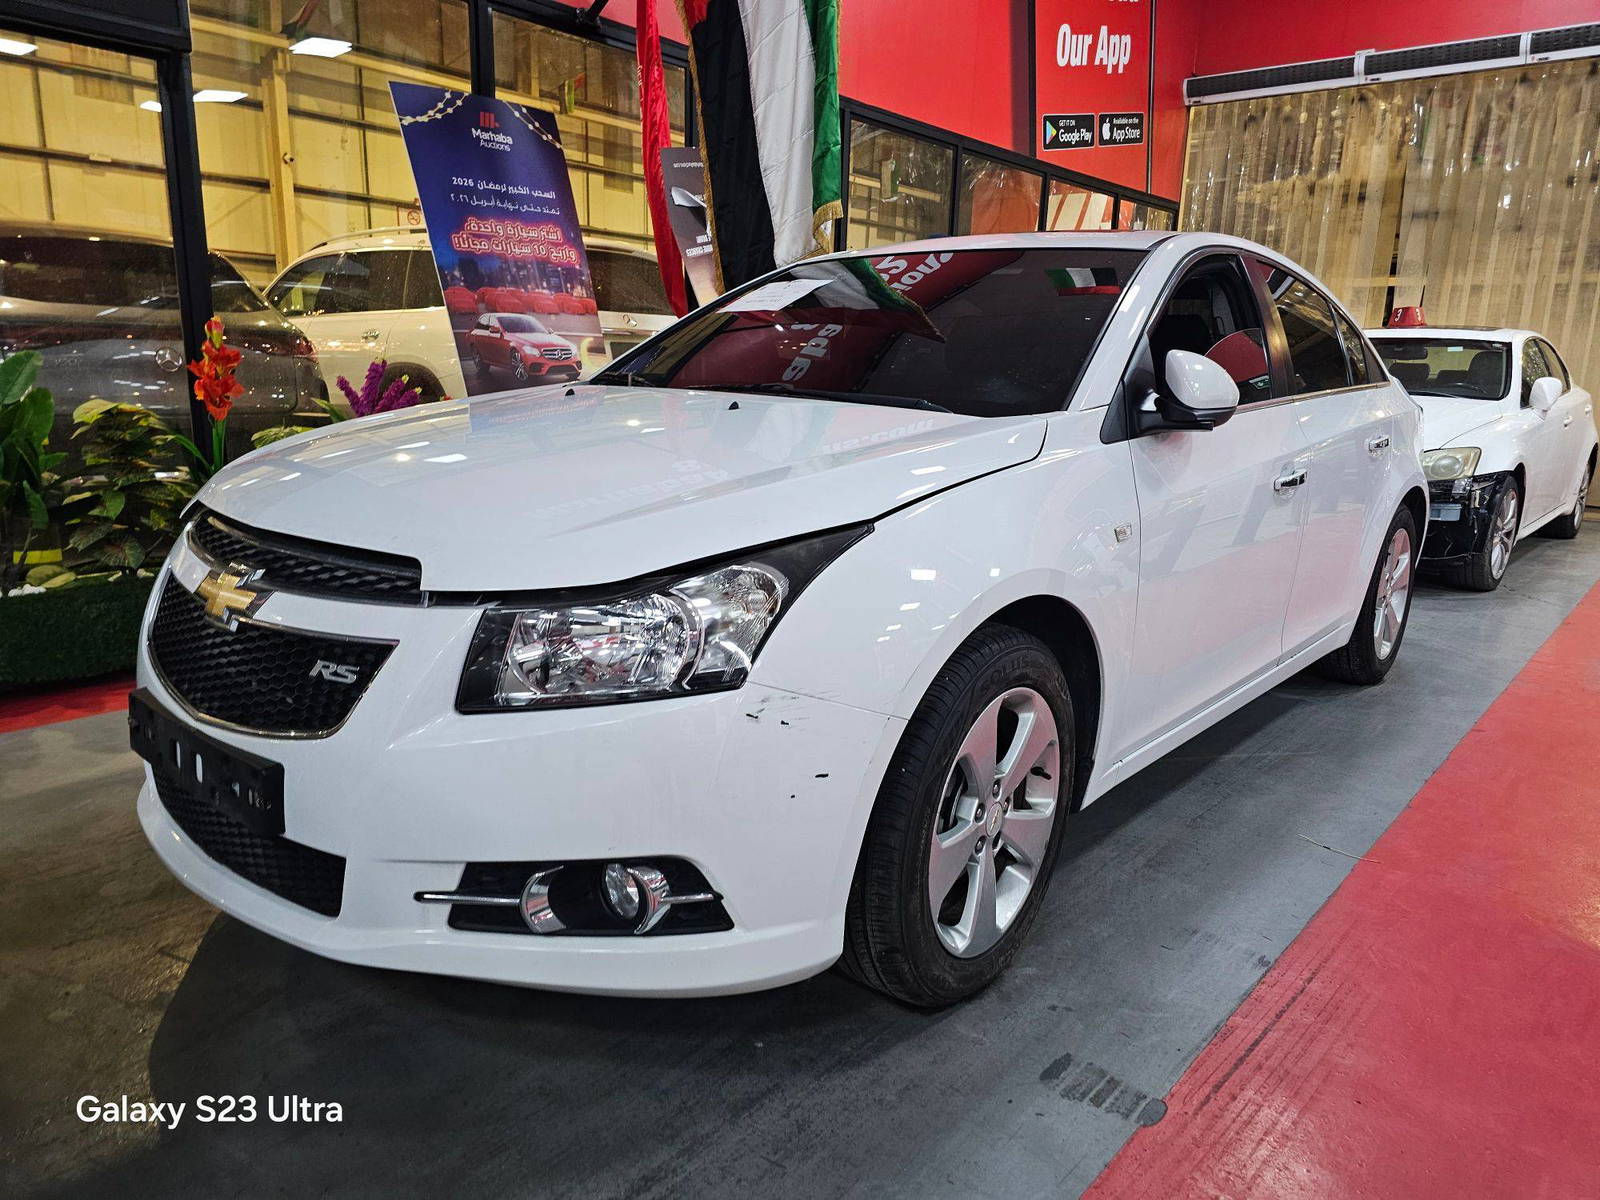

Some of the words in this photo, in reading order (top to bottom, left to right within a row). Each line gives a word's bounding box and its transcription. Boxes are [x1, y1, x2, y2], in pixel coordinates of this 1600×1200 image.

[1056, 23, 1093, 67] Our
[1094, 25, 1131, 75] App
[471, 127, 513, 145] Marhaba
[1059, 128, 1080, 144] Google
[1080, 128, 1092, 143] Play
[1112, 127, 1125, 142] App
[1125, 126, 1140, 139] Store
[480, 139, 511, 152] Auctions
[452, 177, 474, 187] 2026
[477, 180, 507, 193] لرمضان
[508, 185, 530, 195] الكبير
[531, 189, 556, 199] السحب
[506, 222, 539, 238] سيارة
[492, 238, 532, 255] سيارات
[533, 243, 546, 255] 10
[309, 659, 360, 684] RS
